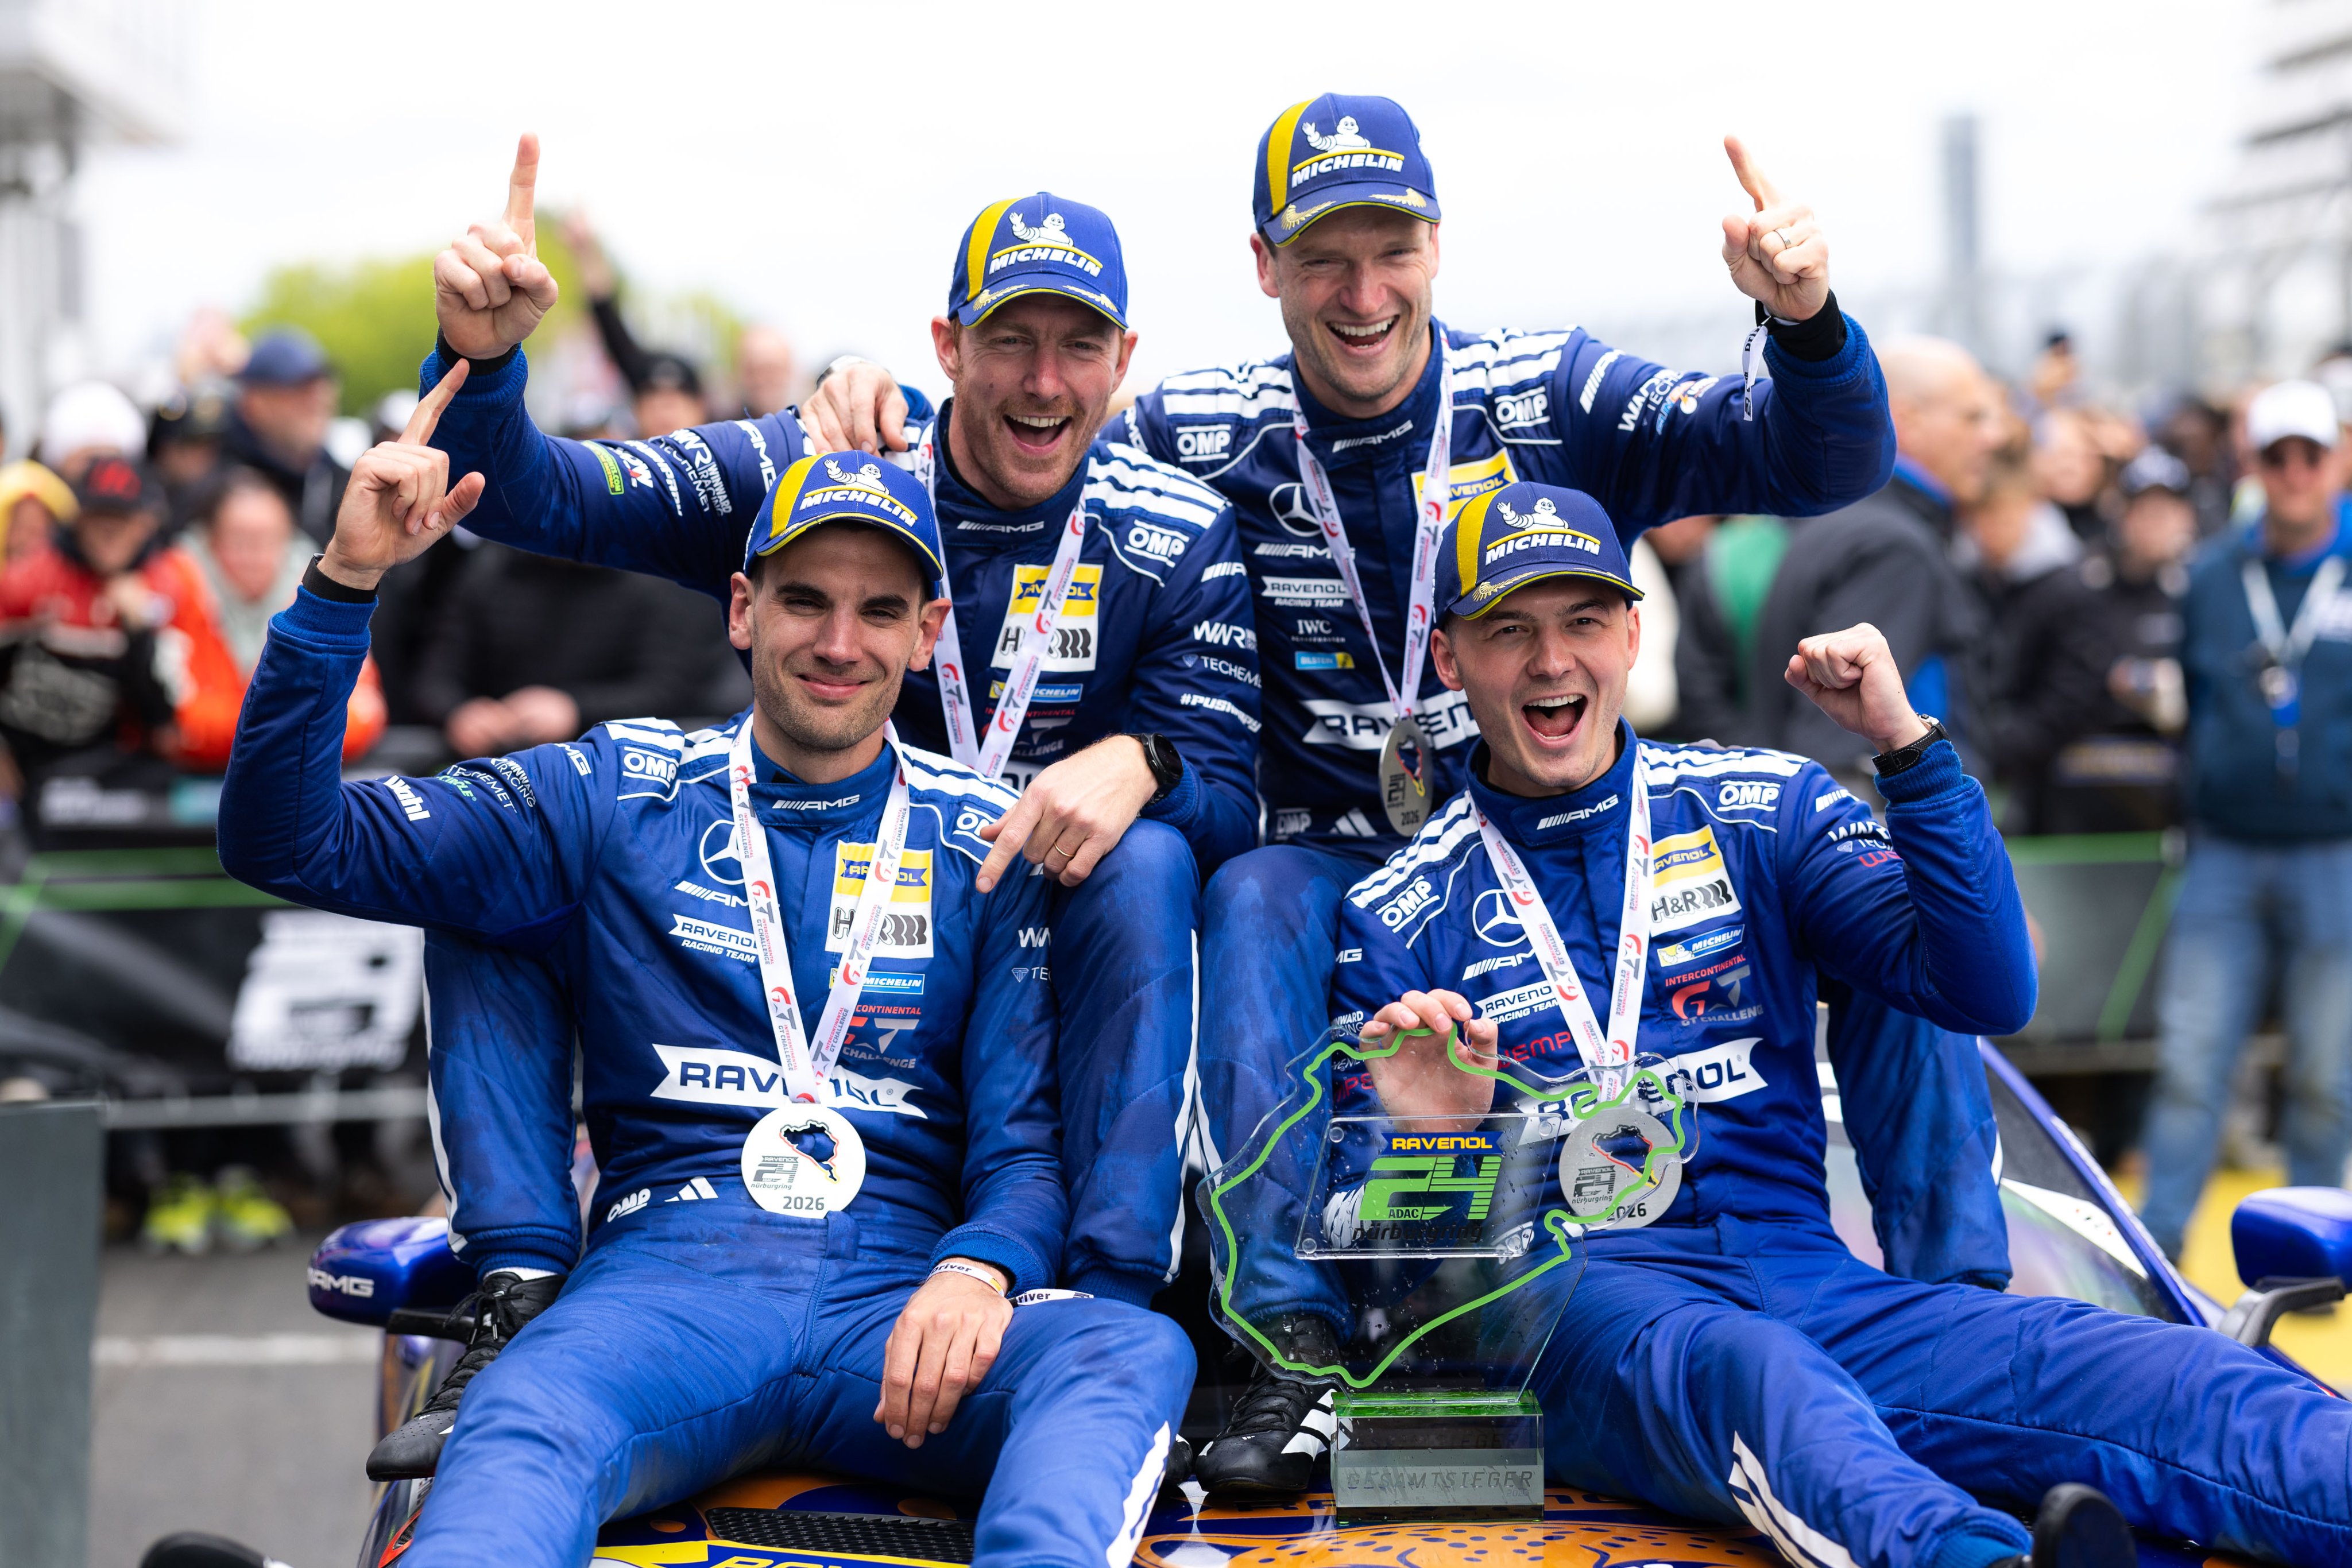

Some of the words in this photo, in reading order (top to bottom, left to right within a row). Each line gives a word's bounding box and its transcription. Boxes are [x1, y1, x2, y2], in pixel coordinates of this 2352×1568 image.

[1292, 154, 1404, 188] MICHELIN
[989, 247, 1101, 278] MICHELIN
[1496, 394, 1548, 423] OMP
[1177, 430, 1231, 455] OMP
[1359, 420, 1413, 446] AMG
[707, 463, 733, 513] WINWARD
[799, 490, 916, 527] MICHELIN
[986, 520, 1045, 533] AMG
[1128, 526, 1186, 557] OMP
[1485, 533, 1600, 566] MICHELIN
[1271, 583, 1347, 594] RAVENOL
[1274, 598, 1312, 607] RACING
[1314, 599, 1344, 608] TEAM
[1297, 619, 1332, 635] IWC
[1034, 687, 1079, 696] ICHELIN
[1012, 739, 1064, 756] ALLENGE
[624, 752, 677, 783] OMP
[383, 775, 431, 822] Wahl
[497, 763, 535, 807] RACING
[1719, 784, 1779, 806] OMP
[802, 794, 860, 811] AMG
[1568, 794, 1619, 823] AMG
[896, 807, 907, 841] CHALLENGE
[740, 823, 749, 858] CHALLENGE
[1382, 880, 1432, 927] OMP
[680, 922, 757, 950] RAVENO
[868, 905, 883, 942] CHALLENGE
[681, 939, 723, 955] RACING
[725, 949, 756, 963] TEAM
[758, 928, 770, 965] CHALLENGE
[1542, 922, 1562, 955] CHALLENGE
[1692, 929, 1742, 951] MICHELIN
[1493, 947, 1535, 971] AM
[1665, 954, 1746, 987] INTERCONTINENTAL
[862, 977, 922, 988] MICHELIN
[856, 1004, 922, 1015] CONTINENTAL
[1485, 986, 1552, 1013] RAVENO
[1616, 978, 1625, 1016] CHALLENGE
[825, 1006, 844, 1051] INTERCONTINENTAL
[833, 1008, 849, 1043] CHALLENGE
[1681, 1016, 1697, 1027] GT
[1585, 1020, 1604, 1055] CHALLENGE
[780, 1035, 794, 1071] CHALLENGE
[1392, 1136, 1492, 1150] RAVENOL
[607, 1188, 651, 1222] OMP
[782, 1196, 825, 1210] 2026
[1388, 1209, 1419, 1219] ADAC
[1572, 1195, 1612, 1205] nürburgring
[1352, 1222, 1483, 1243] nürburgring
[310, 1270, 374, 1298] AMG
[1018, 1292, 1051, 1303] river
[1347, 1470, 1533, 1490] GESAMTSIEGER
